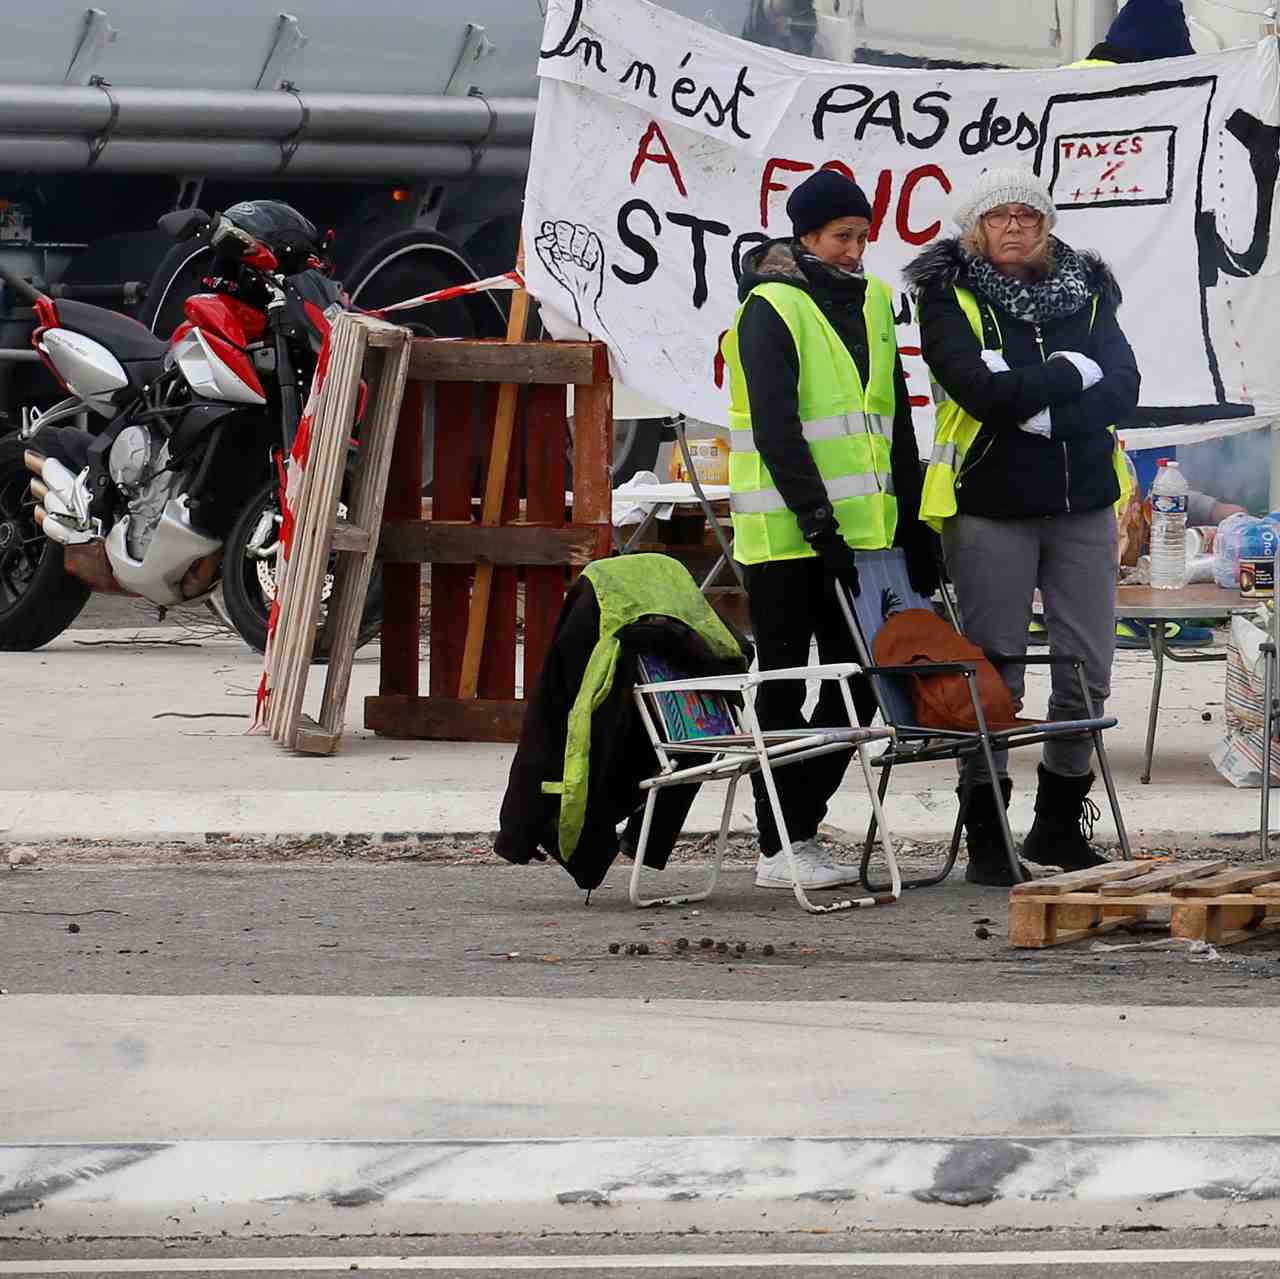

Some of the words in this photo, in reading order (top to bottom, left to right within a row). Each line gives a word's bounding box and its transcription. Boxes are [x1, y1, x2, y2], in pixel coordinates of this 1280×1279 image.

[812, 83, 953, 150] PAS
[958, 97, 1040, 156] des
[1060, 136, 1143, 159] TAXES
[631, 120, 689, 199] A
[760, 157, 953, 246] FIC
